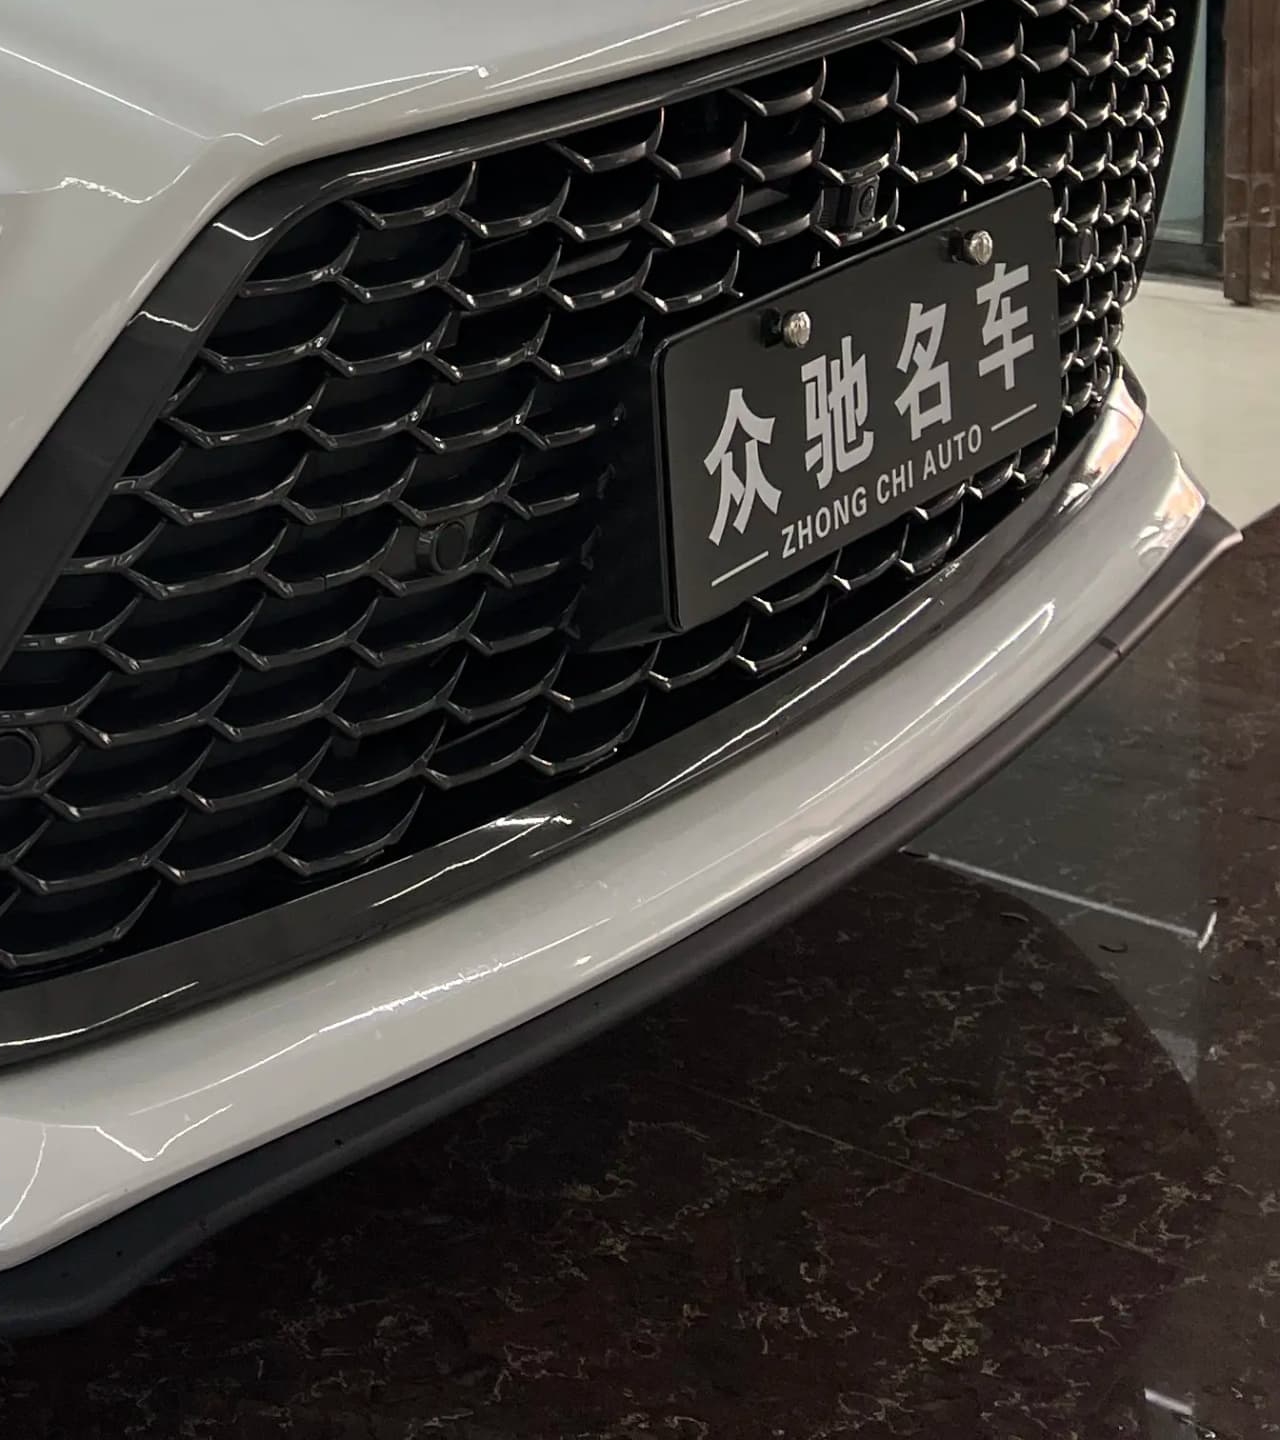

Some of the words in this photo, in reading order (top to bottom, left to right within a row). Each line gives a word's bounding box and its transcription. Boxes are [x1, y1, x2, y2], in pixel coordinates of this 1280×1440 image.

[704, 262, 1035, 546] 众驰名车
[781, 487, 868, 559] ZHONG
[876, 464, 914, 505] CHI
[923, 423, 983, 481] AUTO
